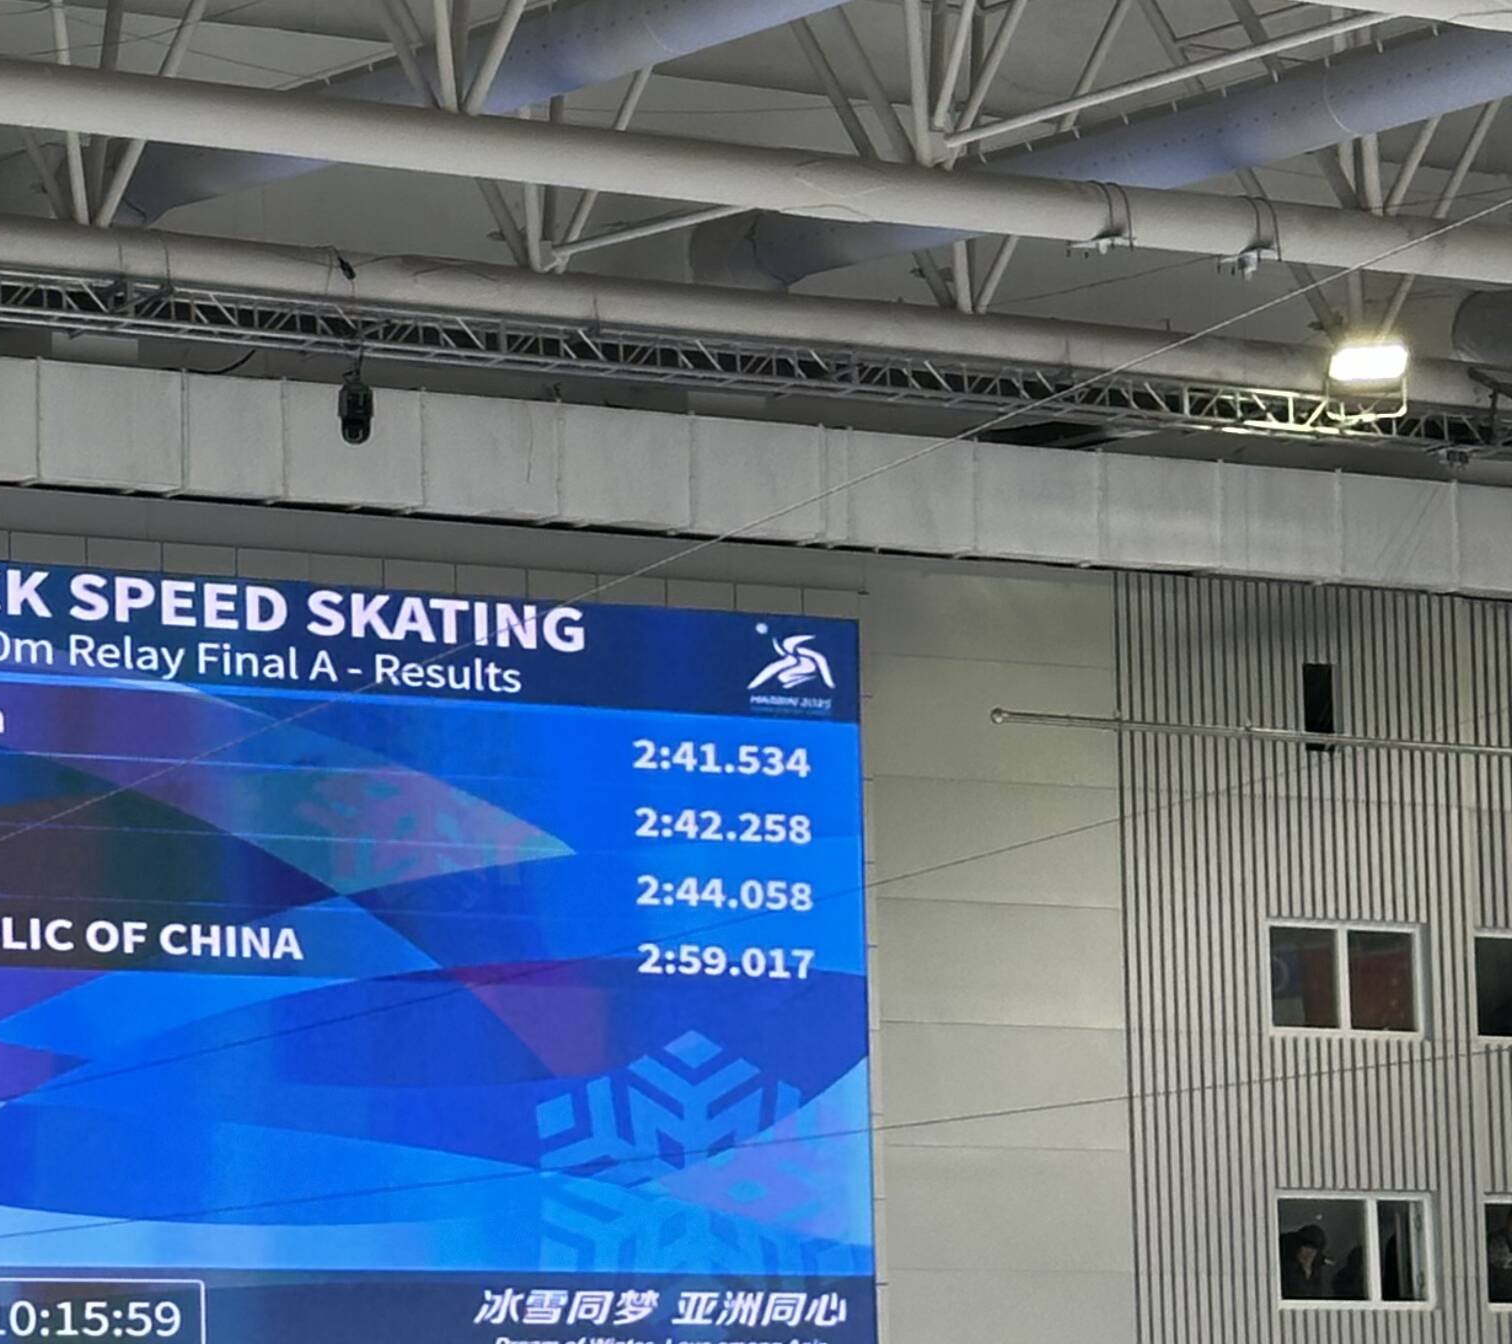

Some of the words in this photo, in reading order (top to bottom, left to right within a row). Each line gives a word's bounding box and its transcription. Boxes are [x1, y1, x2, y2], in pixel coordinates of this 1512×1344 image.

[69, 573, 287, 632] SPEED
[306, 589, 585, 653] SKATING
[69, 633, 184, 680] Relay
[198, 642, 299, 680] Final
[309, 650, 338, 682] A
[375, 653, 522, 693] Results
[633, 739, 811, 778] 2:41.534
[635, 807, 812, 845] 2:42.258
[636, 874, 813, 912] 2:44.058
[85, 920, 148, 954] OF
[159, 923, 303, 960] CHINA
[638, 943, 814, 979] 2:59.017
[473, 1288, 659, 1326] 冰雪同梦
[671, 1291, 847, 1327] 亚洲同心
